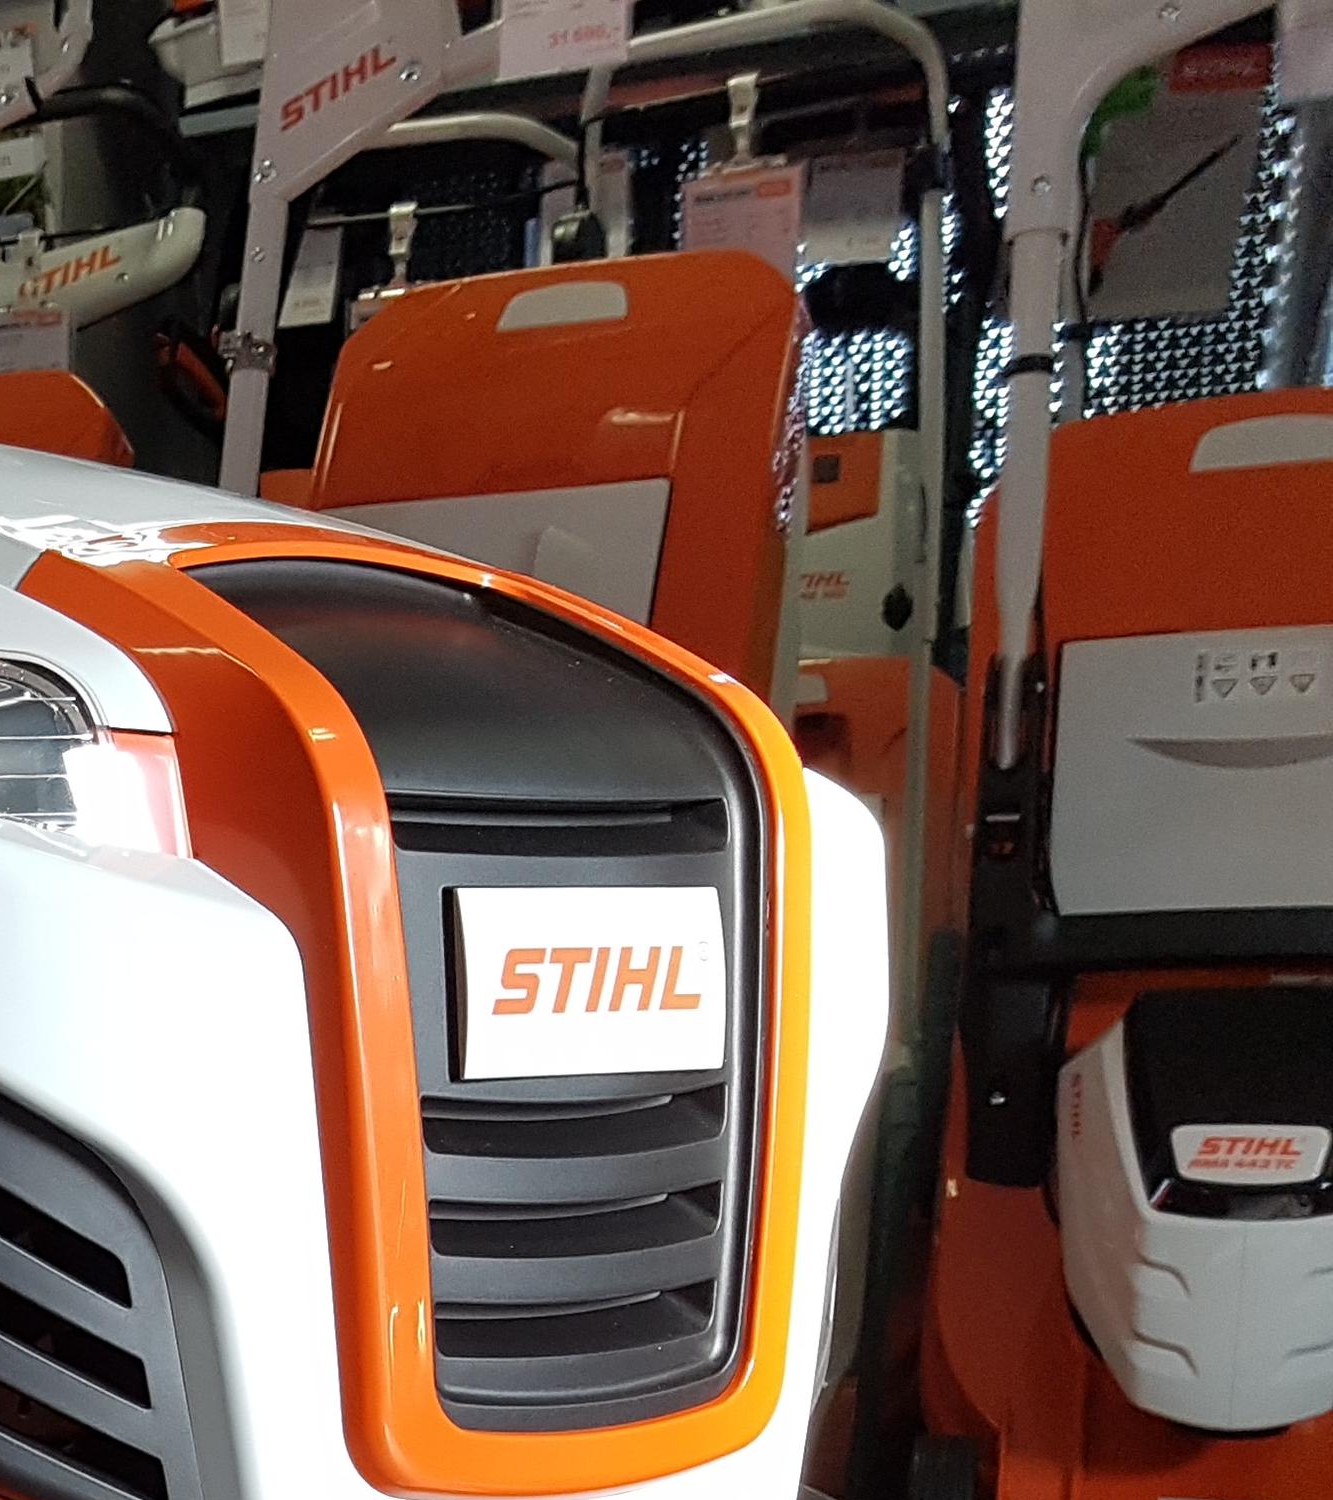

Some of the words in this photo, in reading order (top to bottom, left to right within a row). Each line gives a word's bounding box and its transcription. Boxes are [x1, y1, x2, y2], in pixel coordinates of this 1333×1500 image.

[279, 45, 397, 132] STIHL
[491, 946, 702, 1015] STIHL
[1198, 1136, 1302, 1156] STIHL
